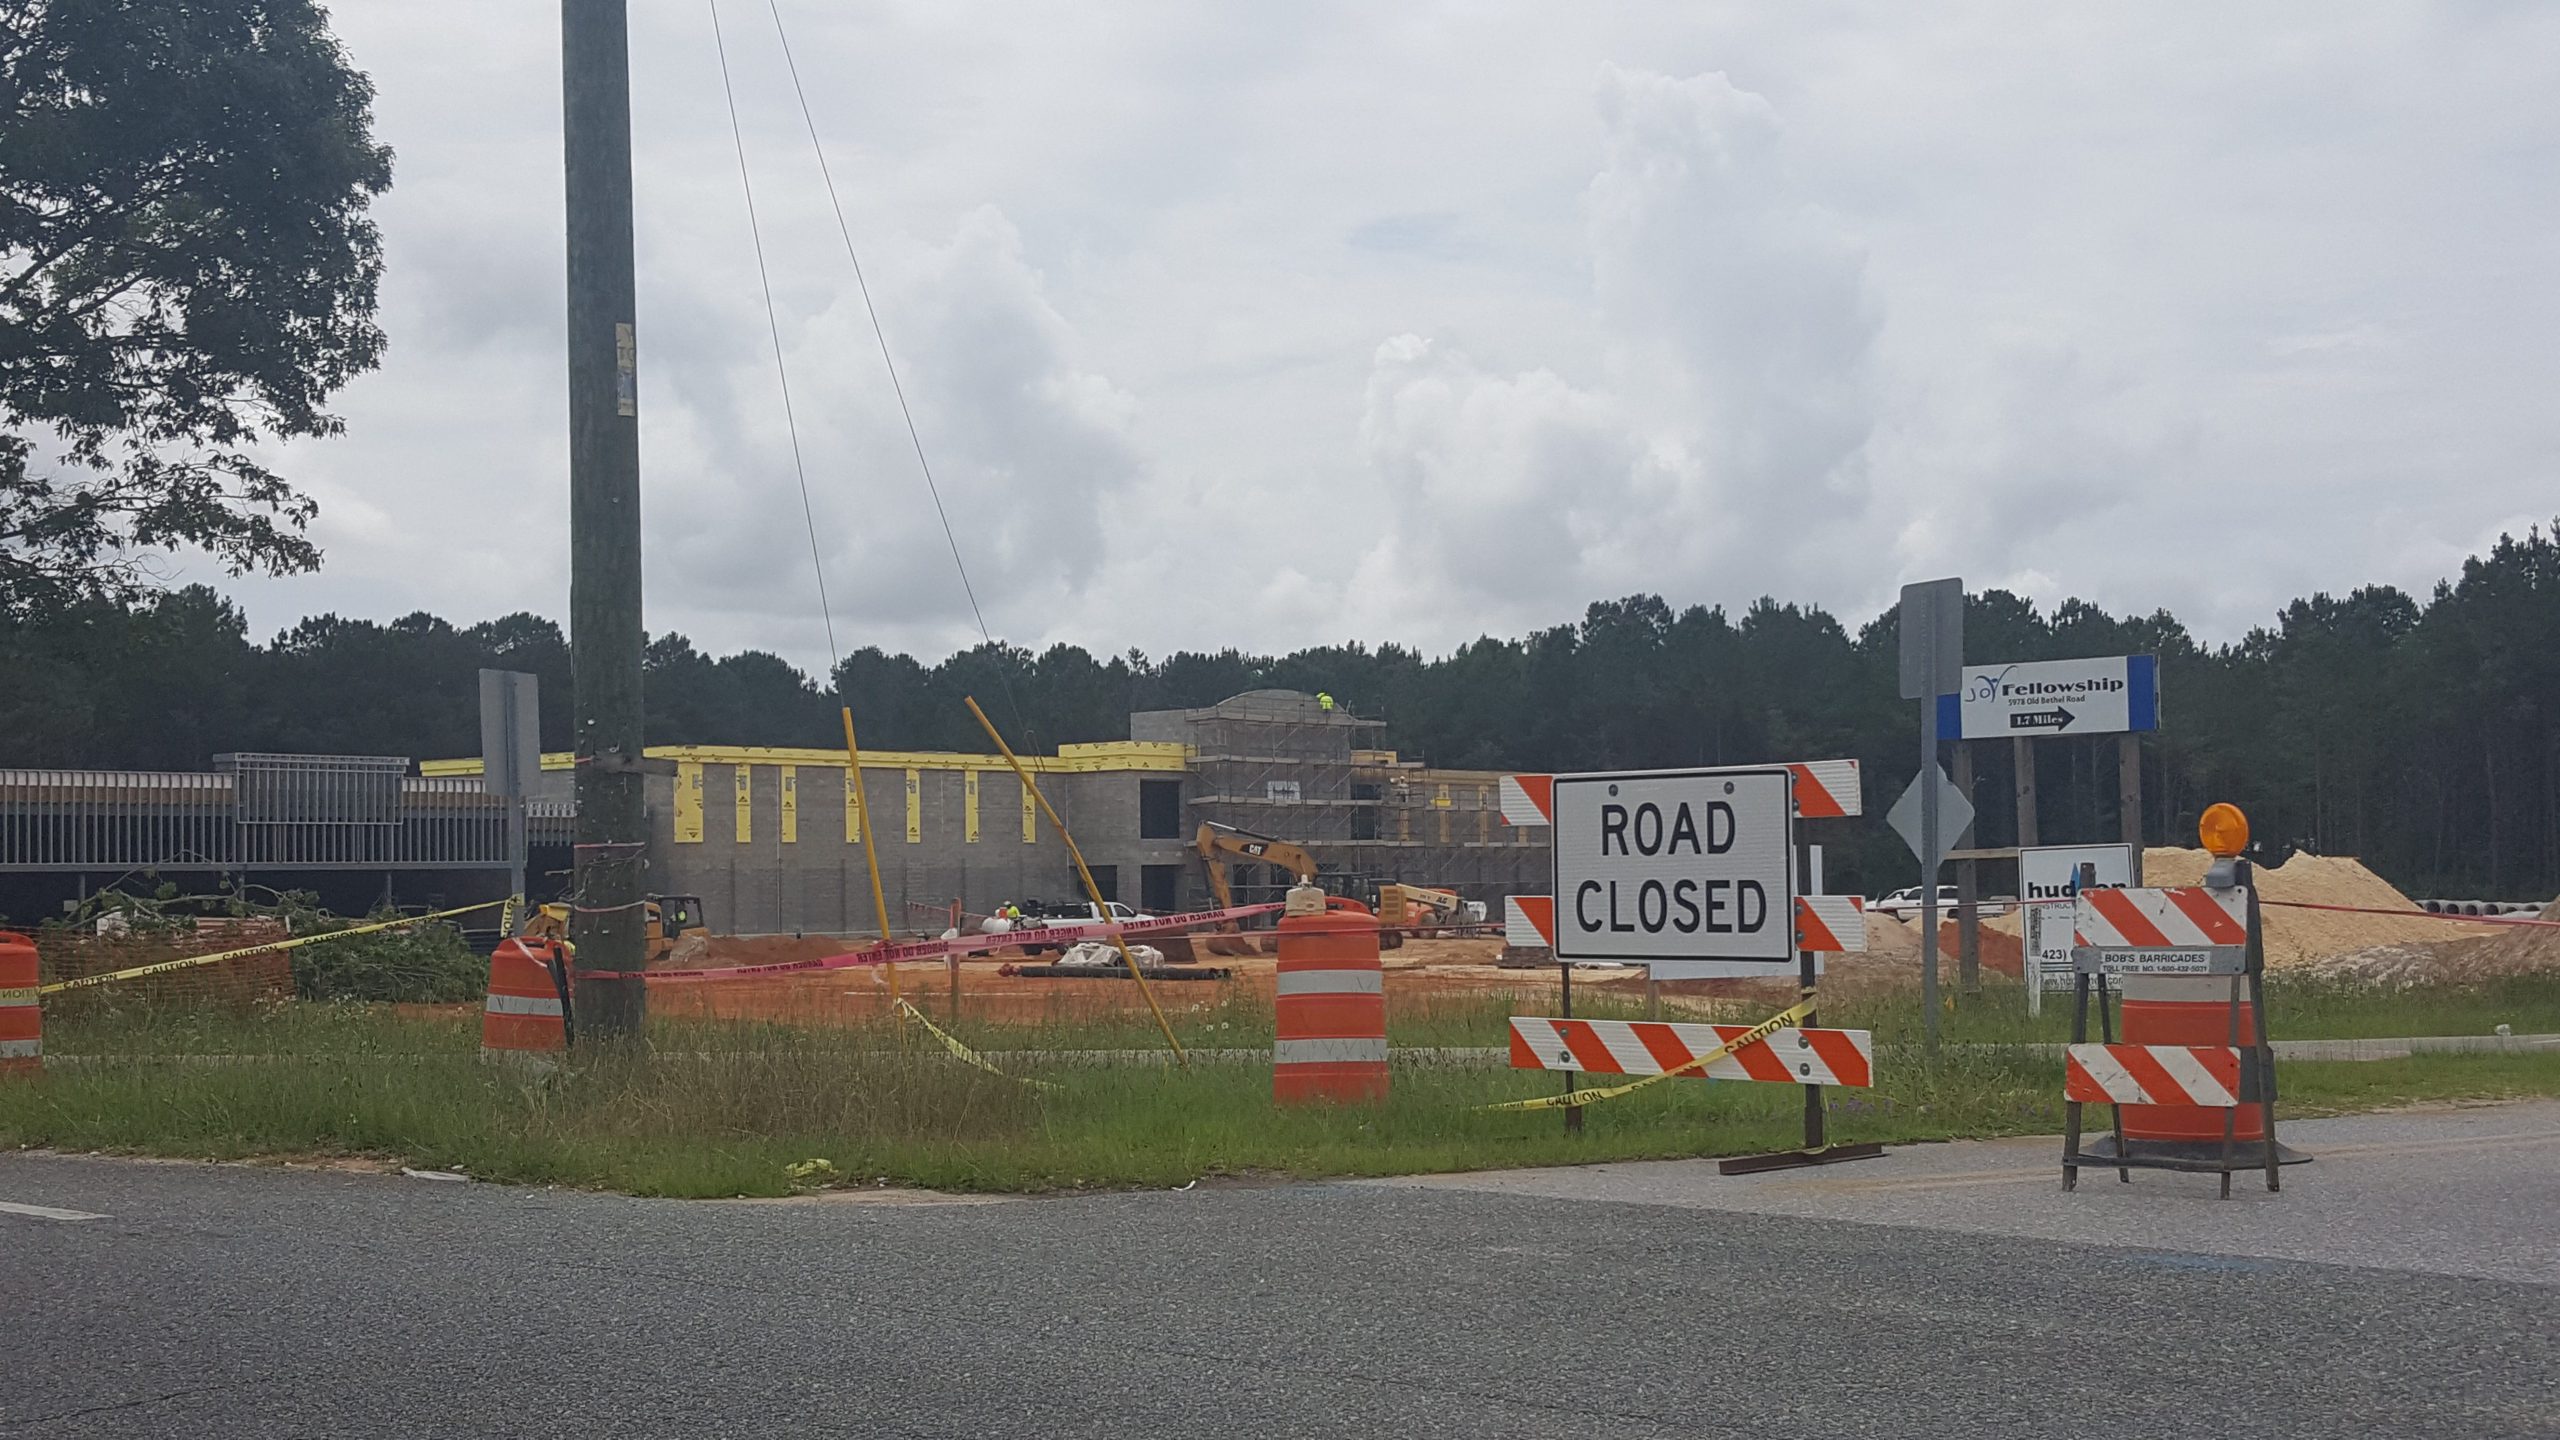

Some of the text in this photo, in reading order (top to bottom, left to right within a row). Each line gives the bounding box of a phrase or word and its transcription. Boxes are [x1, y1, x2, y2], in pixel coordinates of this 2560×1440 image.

[2002, 677, 2124, 697] Fellowship
[2026, 697, 2040, 705] Old
[2041, 696, 2066, 704] Bethel
[2066, 694, 2086, 703] Road
[2032, 714, 2064, 725] Miles
[1601, 801, 1736, 856] ROAD
[1248, 844, 1263, 856] CAT
[1576, 879, 1767, 934] CLOSED
[2041, 949, 2067, 961] 423)
[2104, 953, 2206, 963] BOB'S BARRICADES
[142, 960, 198, 976] CAUTION
[1724, 1012, 1794, 1054] CAUTION
